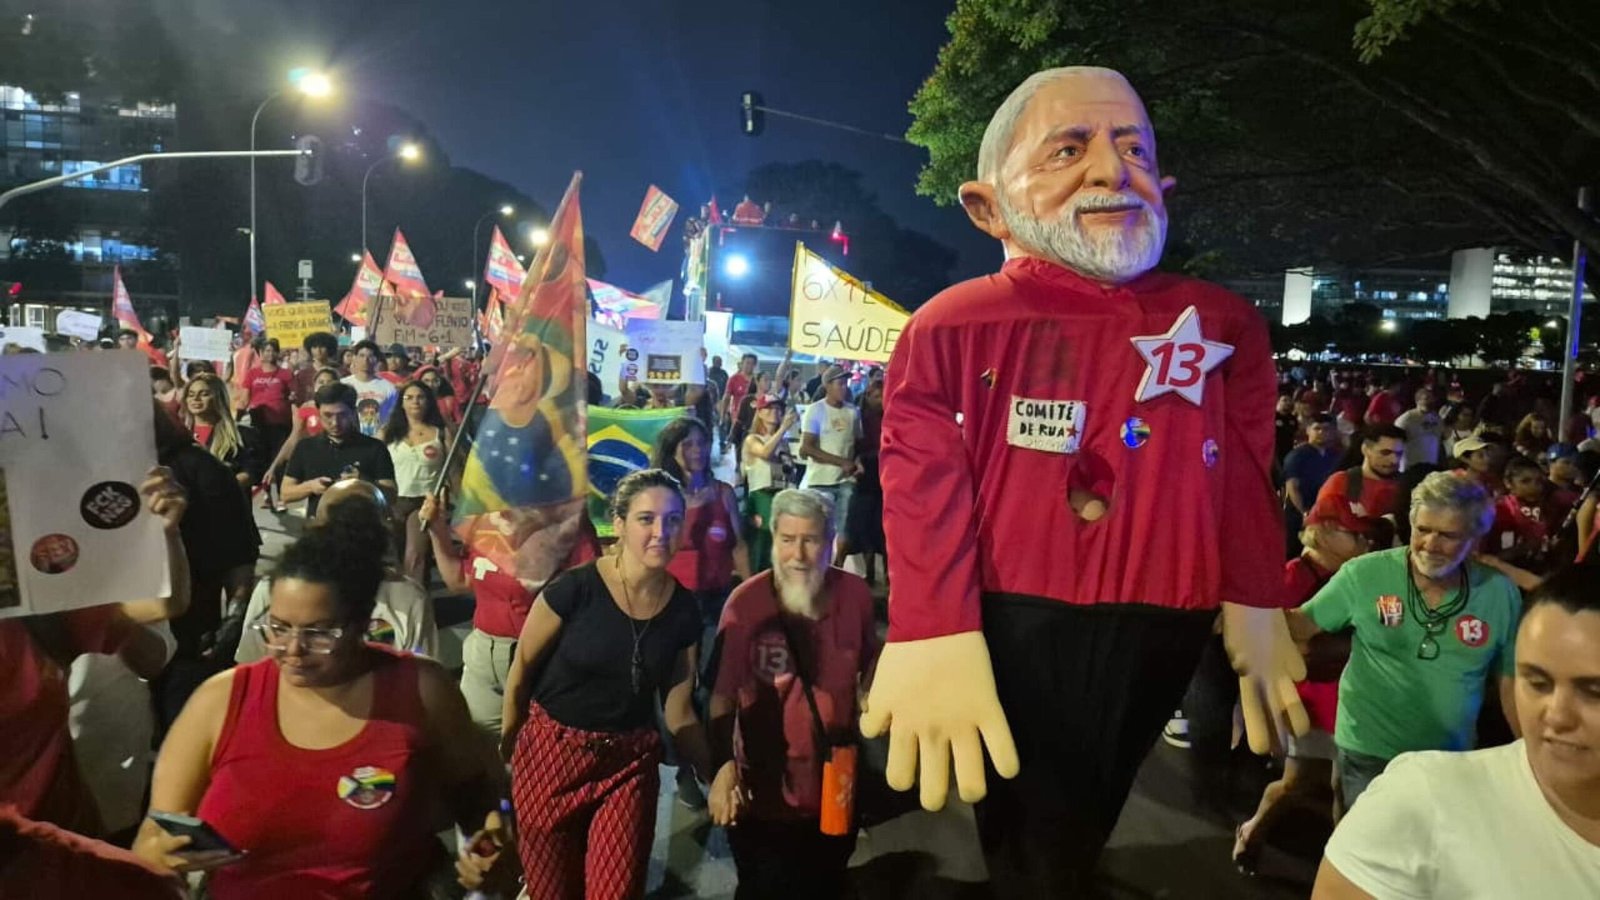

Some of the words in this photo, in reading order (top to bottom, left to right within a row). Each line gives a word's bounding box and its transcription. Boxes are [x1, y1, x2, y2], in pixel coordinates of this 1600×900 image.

[802, 318, 900, 354] SAÚDE
[1151, 340, 1206, 388] 13
[1019, 422, 1034, 436] DE
[1039, 424, 1065, 438] RUA
[1460, 618, 1483, 642] 13
[757, 645, 789, 673] 13
